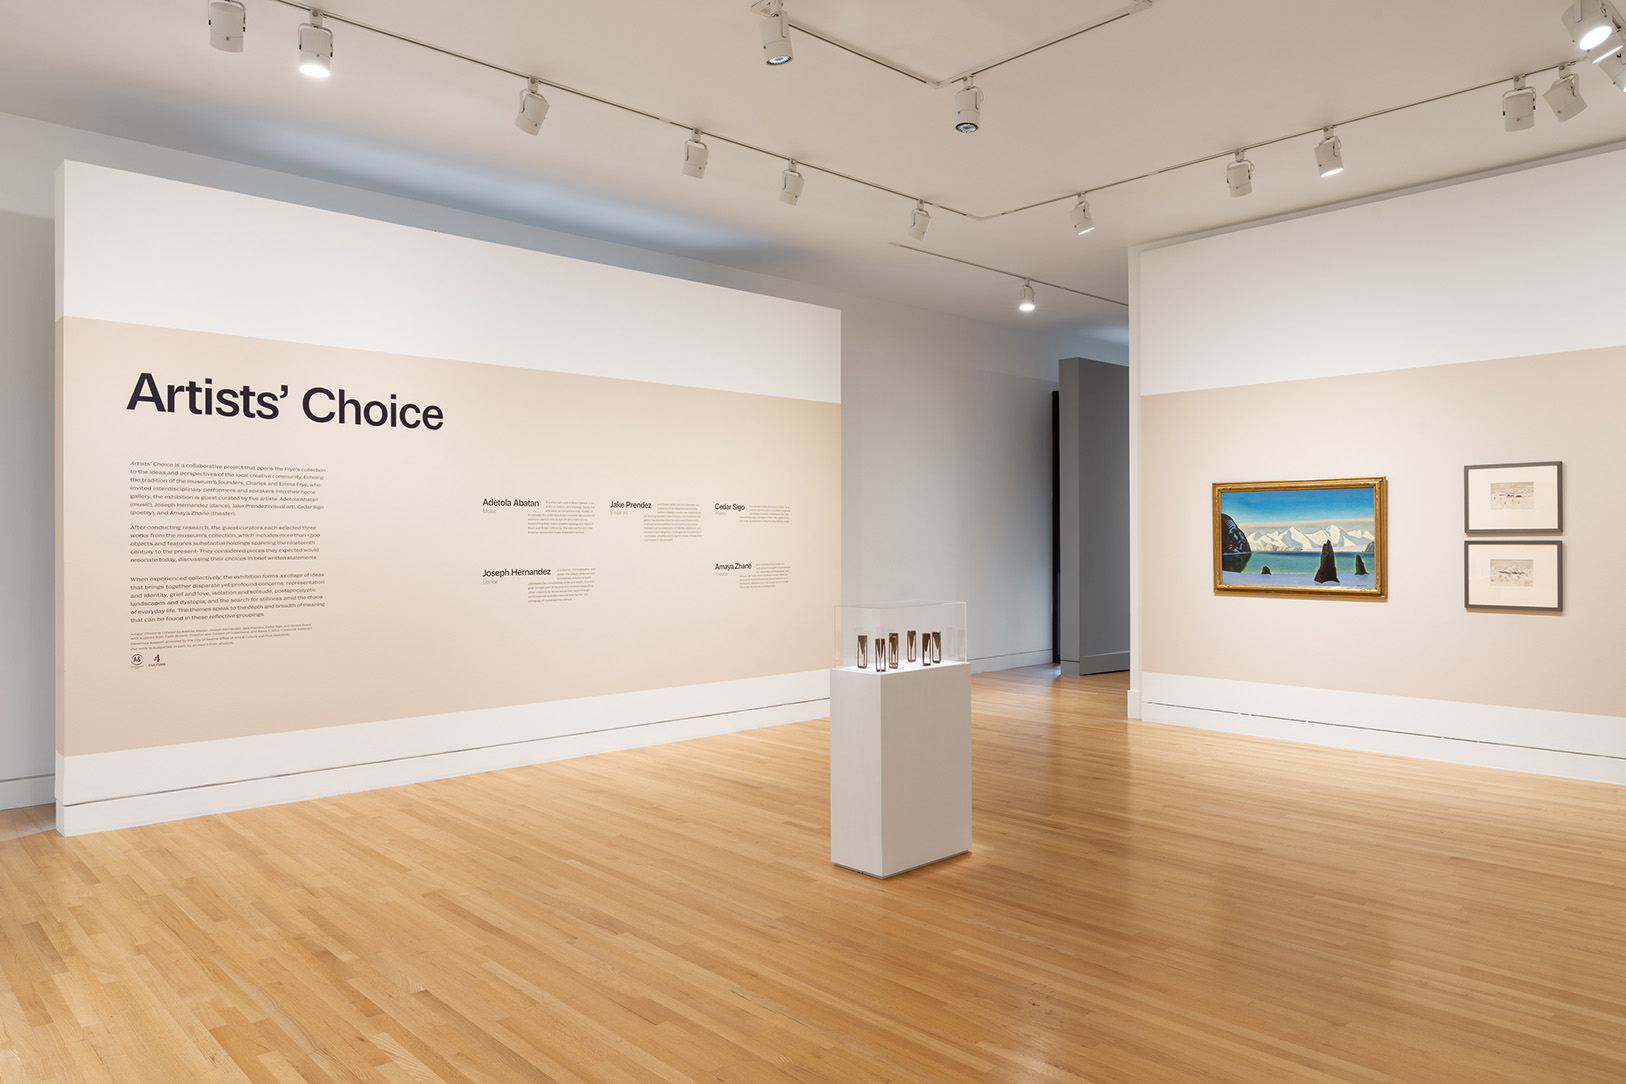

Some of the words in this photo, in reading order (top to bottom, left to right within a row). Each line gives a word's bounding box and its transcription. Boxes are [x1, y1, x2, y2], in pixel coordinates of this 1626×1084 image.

[126, 372, 289, 420] Artists’
[302, 387, 444, 430] Choice
[482, 498, 512, 506] Adetola
[732, 503, 745, 512] Sigo
[482, 569, 510, 577] Joseph
